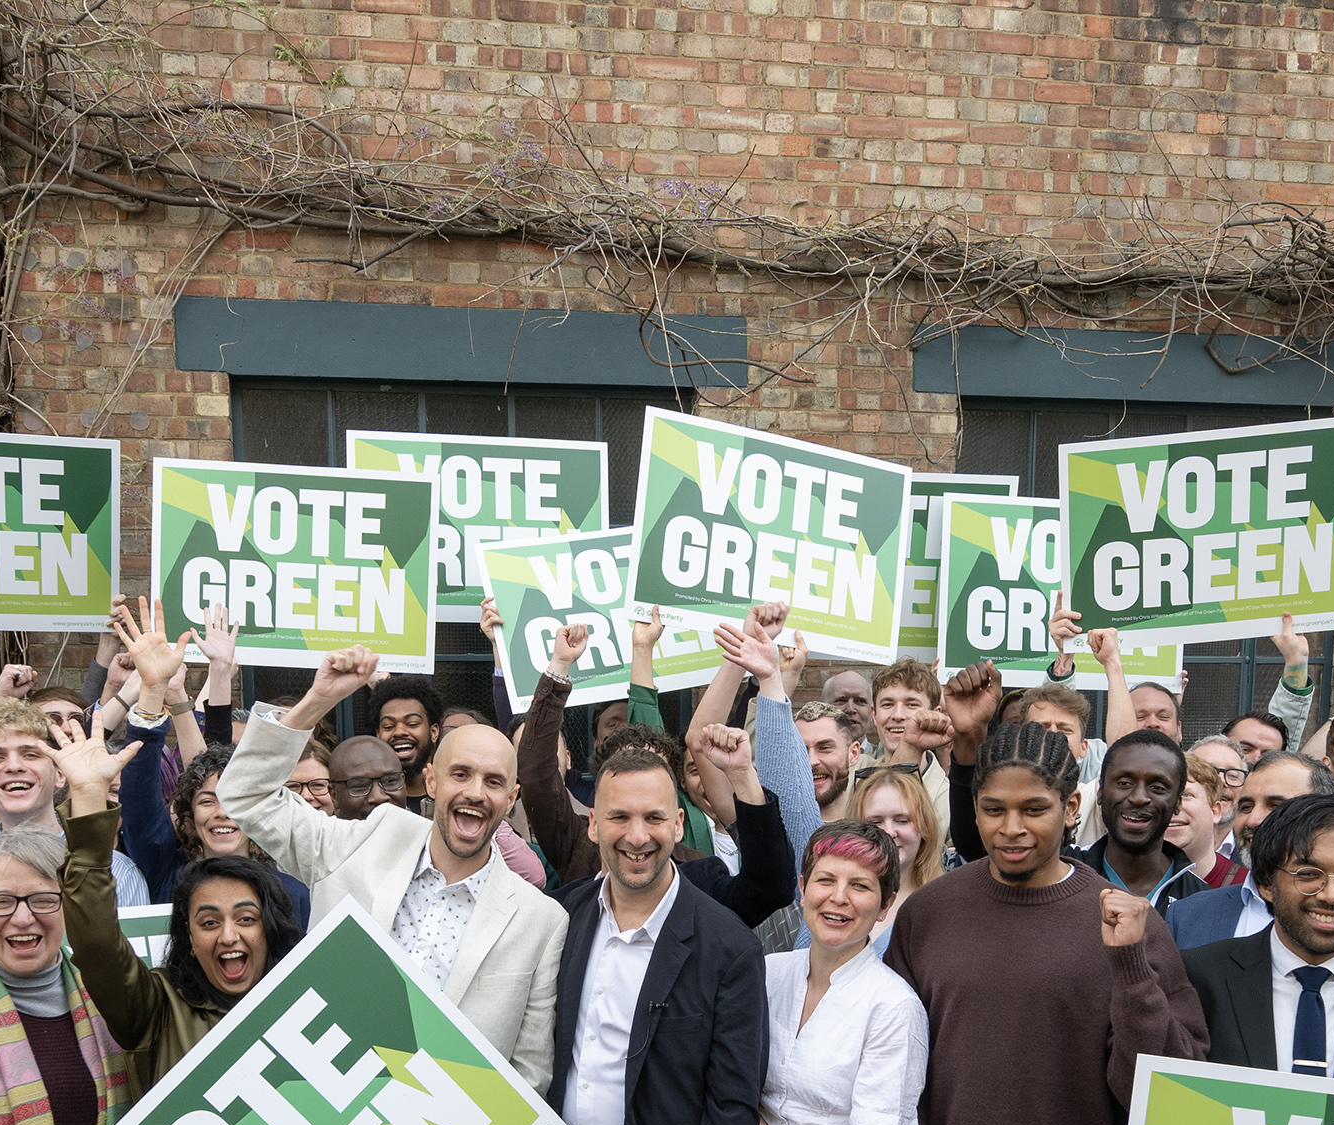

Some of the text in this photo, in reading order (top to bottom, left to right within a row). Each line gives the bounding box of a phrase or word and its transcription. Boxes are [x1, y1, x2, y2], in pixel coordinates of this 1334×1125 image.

[206, 483, 386, 560] VOTE
[697, 441, 864, 544] VOTE
[1116, 445, 1313, 533] VOTE
[529, 544, 631, 610] VO
[661, 516, 877, 621] GREEN
[990, 516, 1061, 584] VO
[1094, 523, 1333, 611] GREEN
[182, 557, 405, 634] GREEN
[667, 614, 683, 622] Party
